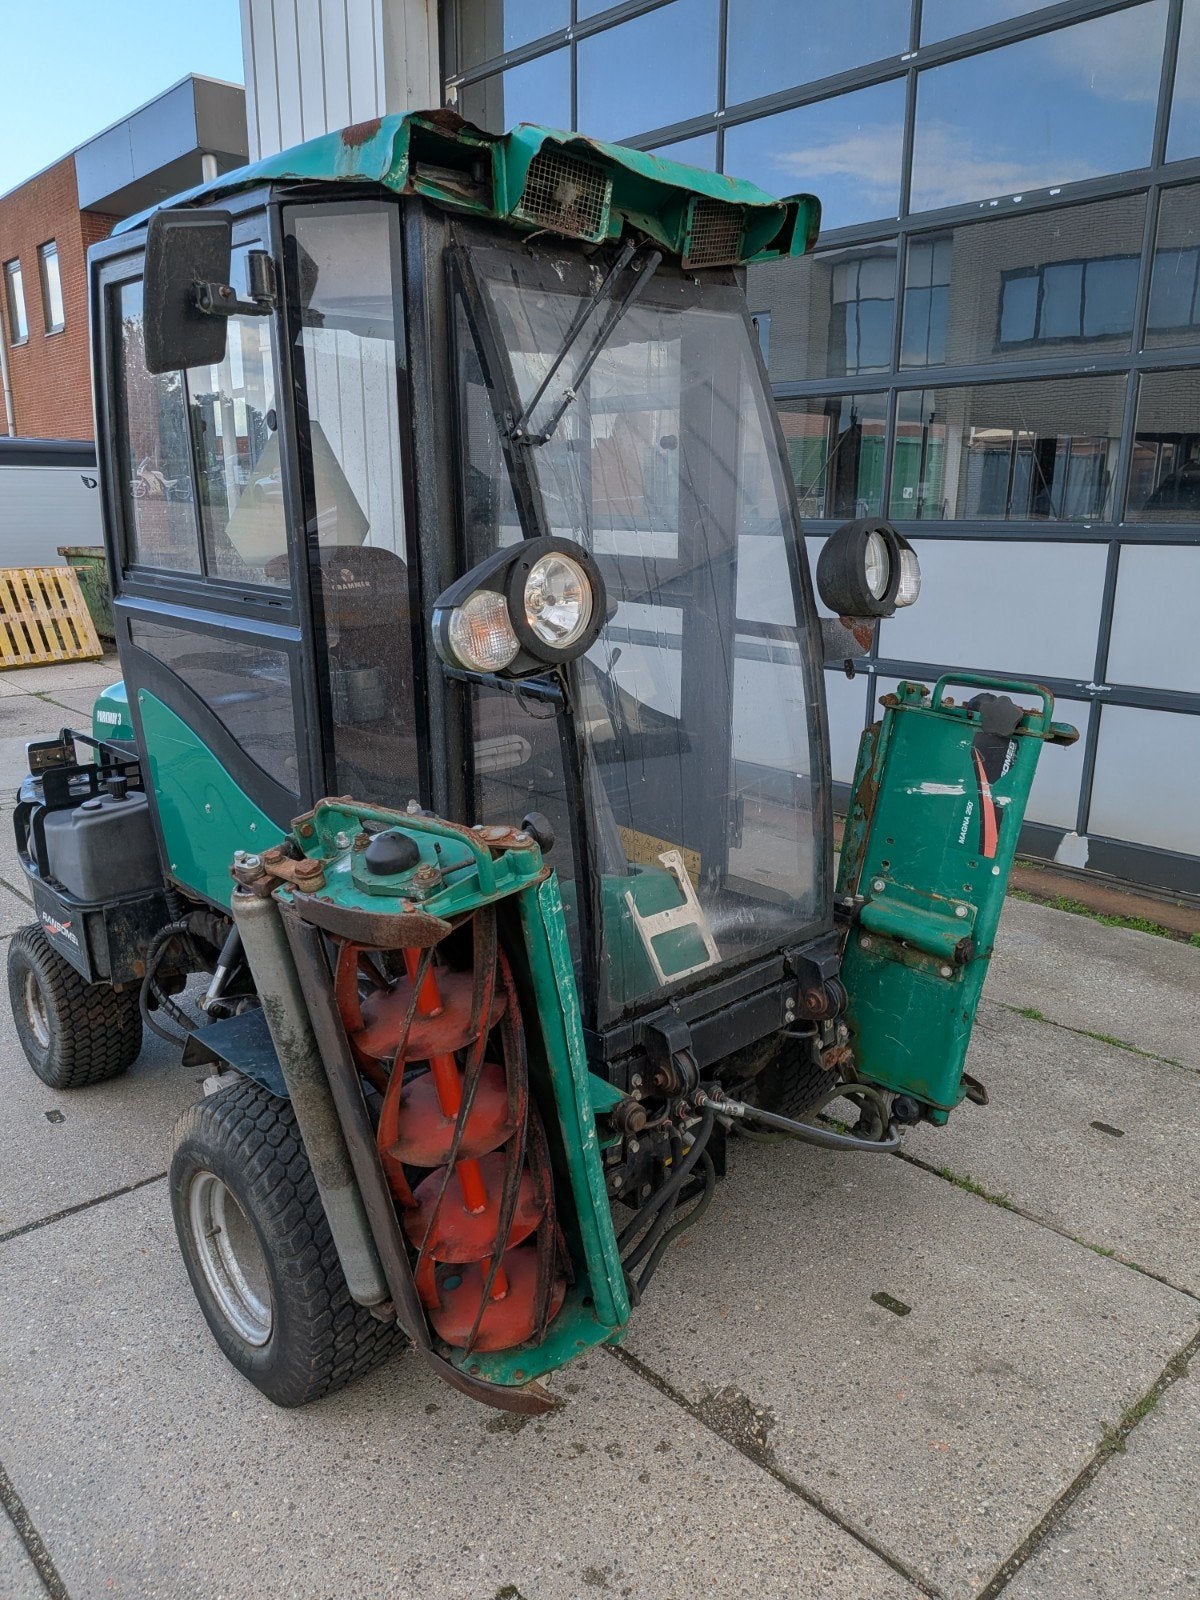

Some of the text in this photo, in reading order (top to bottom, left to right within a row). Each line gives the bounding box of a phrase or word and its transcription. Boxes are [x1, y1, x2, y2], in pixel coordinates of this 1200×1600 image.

[117, 712, 122, 726] 3
[958, 800, 974, 845] MAGNA 250
